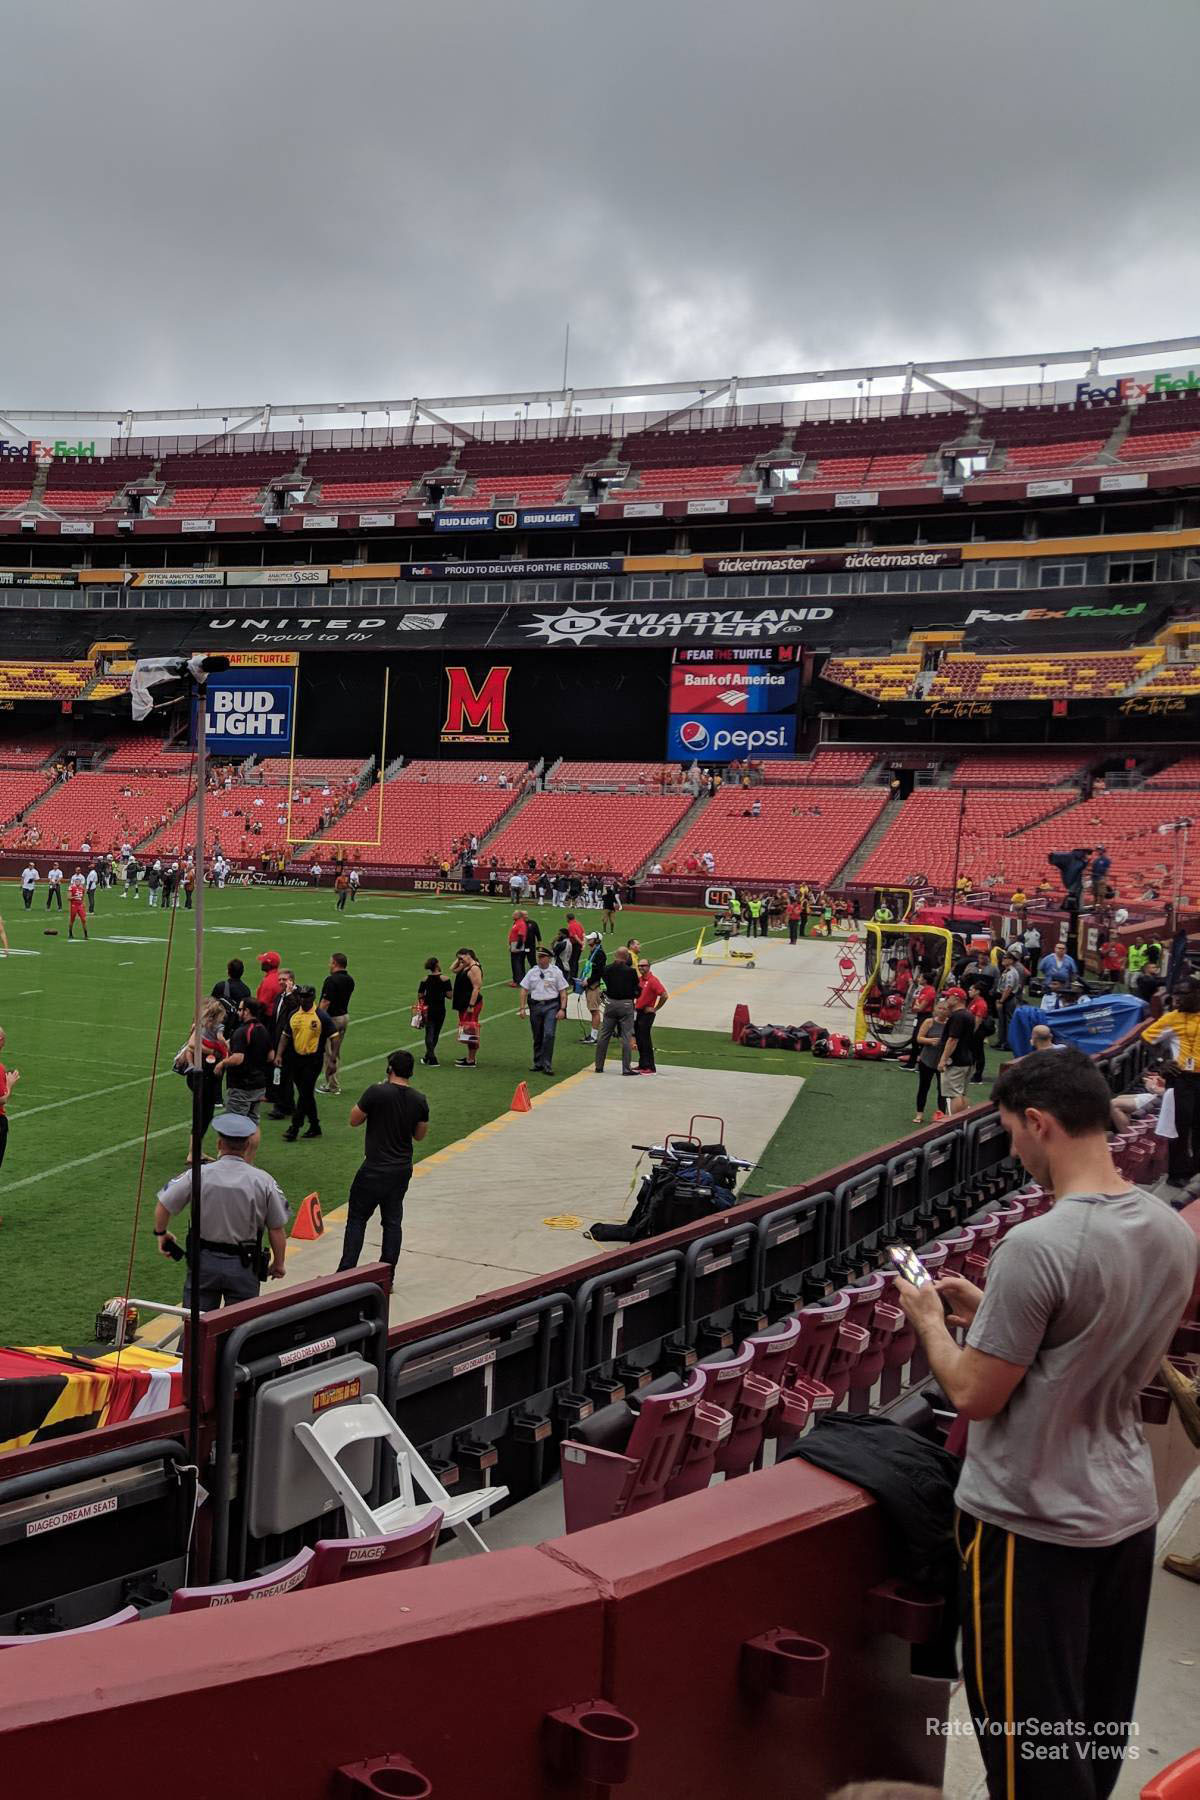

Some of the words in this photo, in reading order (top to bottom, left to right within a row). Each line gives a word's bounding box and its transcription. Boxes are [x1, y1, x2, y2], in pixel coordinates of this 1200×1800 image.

[0, 440, 95, 458] FedExField
[439, 518, 462, 527] BUD
[463, 517, 489, 525] LIGHT
[499, 515, 513, 526] 40
[523, 515, 546, 524] BUD
[547, 513, 575, 522] LIGHT
[718, 558, 810, 572] ticketmaster
[845, 552, 942, 568] ticketmaster
[444, 566, 475, 574] PROUD
[475, 566, 487, 574] TO
[488, 564, 525, 574] DELIVER
[526, 564, 544, 572] FOR
[544, 563, 562, 571] THE
[301, 572, 320, 581] sas
[624, 608, 834, 625] MARYLAND
[964, 602, 1147, 624] FedExField
[209, 619, 386, 629] UNITED
[616, 621, 787, 636] LOTTERY
[251, 633, 313, 642] Proud
[318, 633, 339, 641] to
[345, 632, 374, 642] fly
[685, 674, 715, 686] Bank
[718, 673, 731, 686] of
[731, 673, 786, 686] America
[214, 691, 275, 713] BUD
[441, 666, 512, 732] M
[205, 713, 285, 735] LIGHT
[714, 726, 786, 751] pepsi
[28, 1517, 61, 1535] DIAGEO
[62, 1508, 91, 1524] DREAM
[93, 1499, 116, 1514] SEATS
